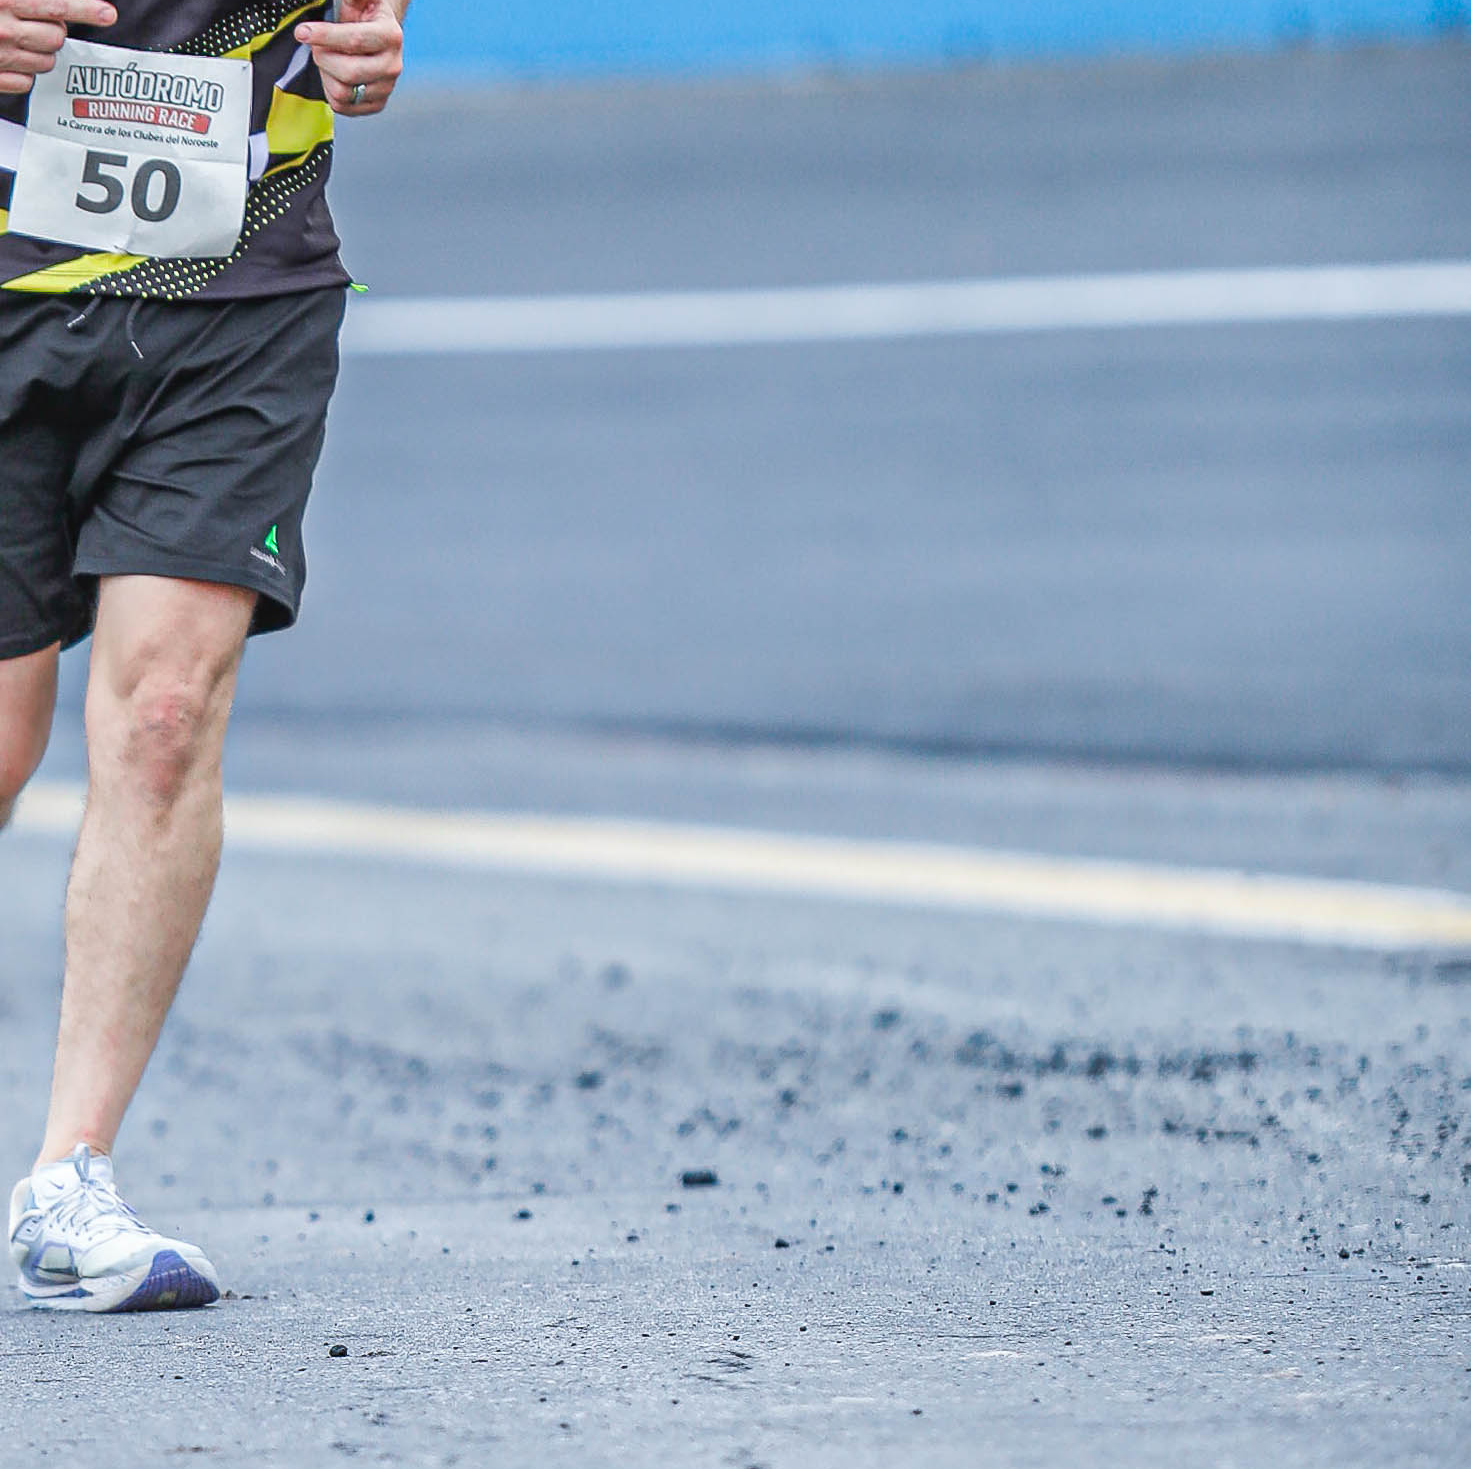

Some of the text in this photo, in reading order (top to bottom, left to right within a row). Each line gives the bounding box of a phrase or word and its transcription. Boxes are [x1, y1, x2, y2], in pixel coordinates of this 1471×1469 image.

[66, 62, 225, 113] AUTÓDROMO
[57, 116, 219, 148] La Carrera de los Clubes del Noroeste
[88, 101, 197, 130] RUNNING RACE
[75, 149, 182, 222] 50
